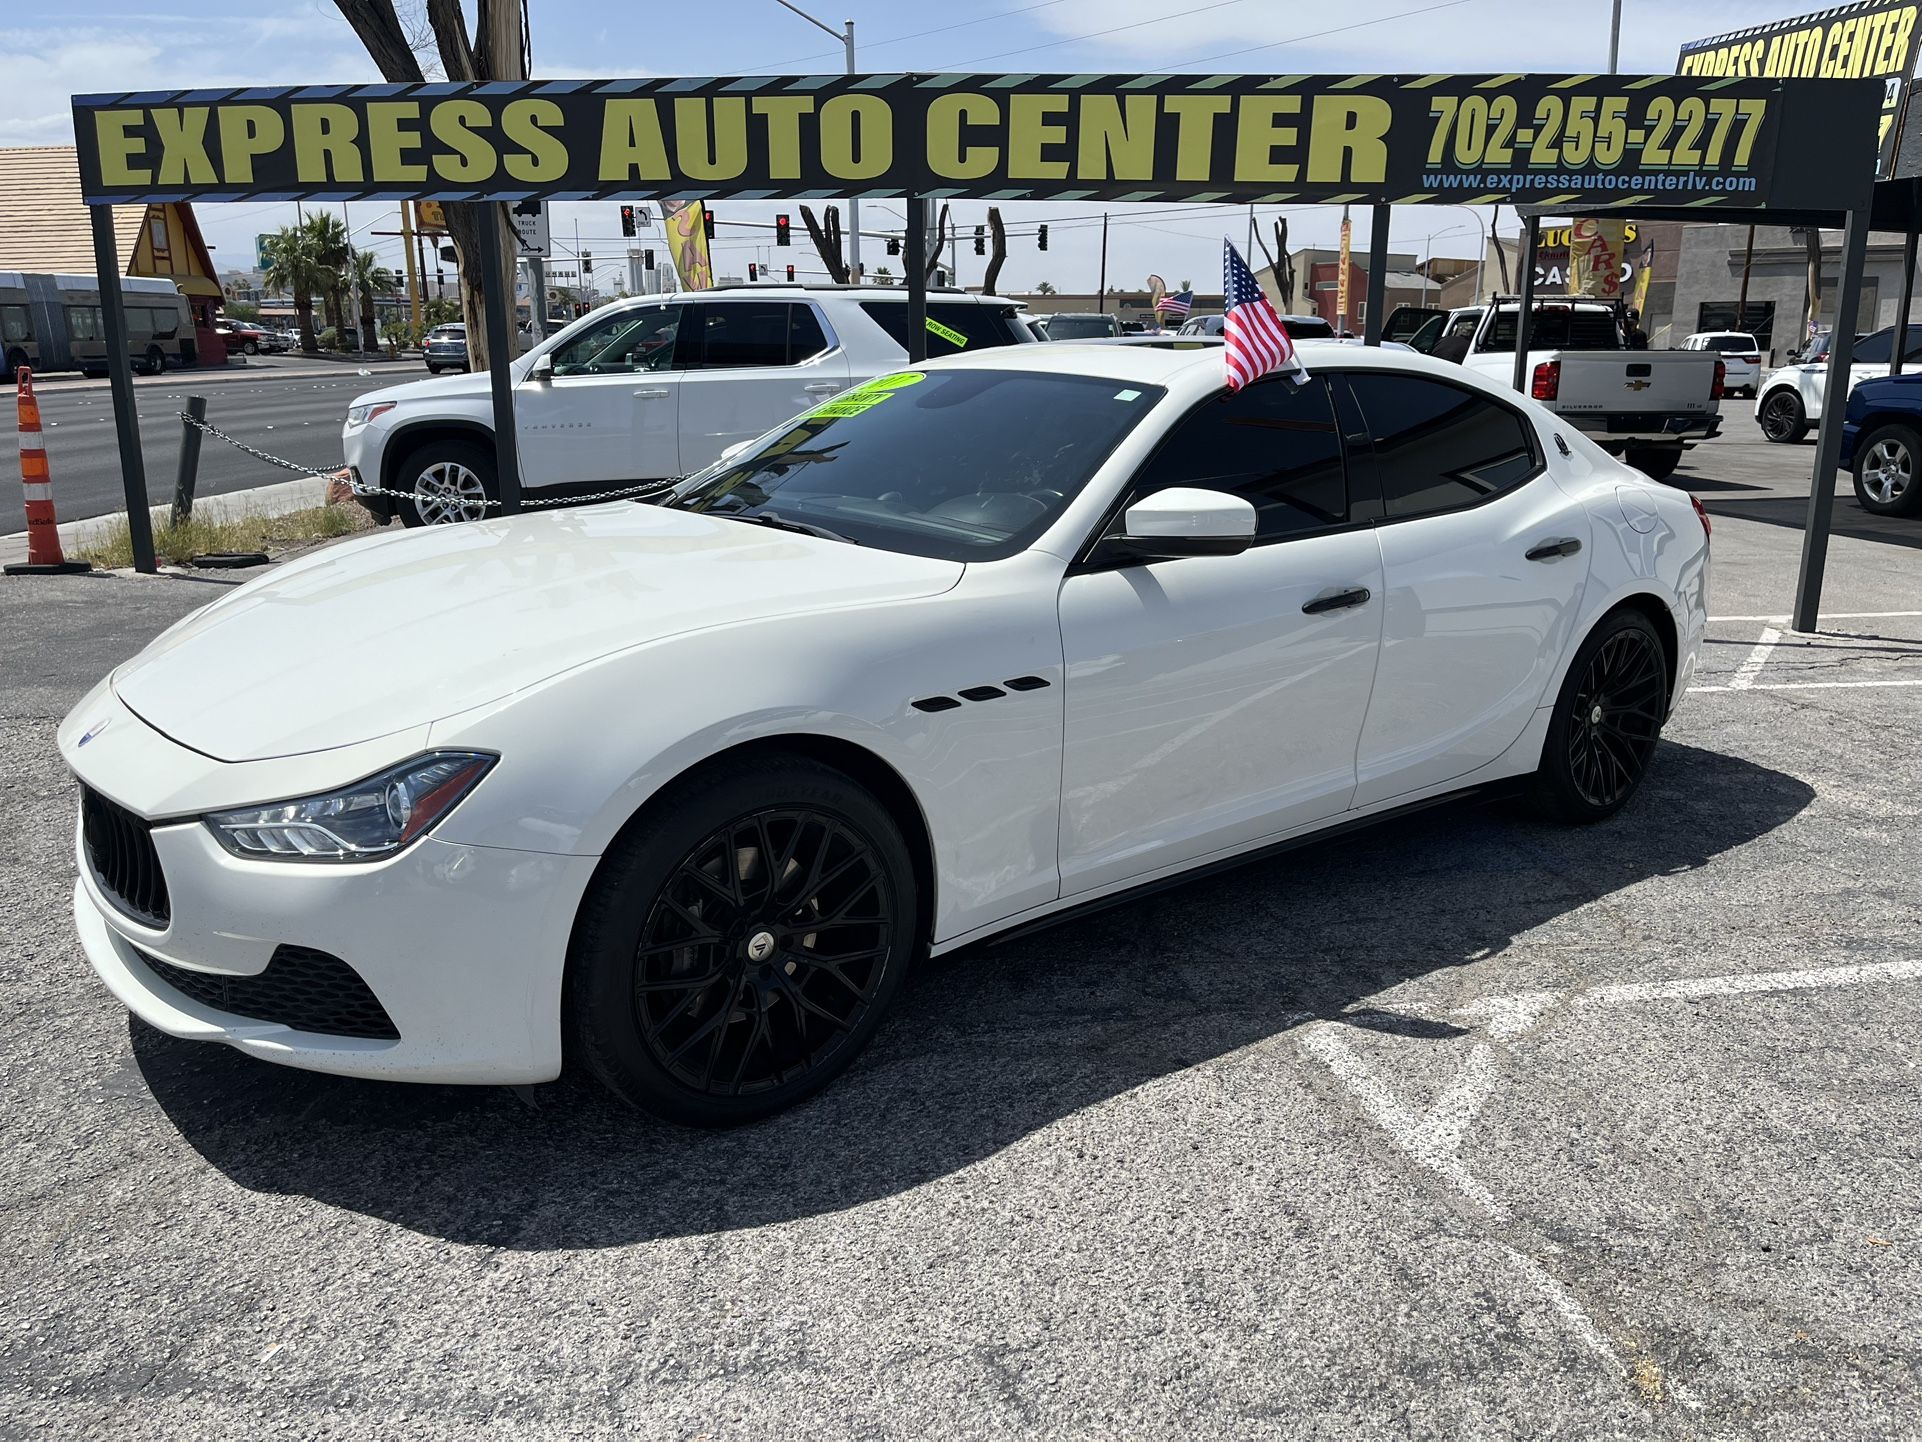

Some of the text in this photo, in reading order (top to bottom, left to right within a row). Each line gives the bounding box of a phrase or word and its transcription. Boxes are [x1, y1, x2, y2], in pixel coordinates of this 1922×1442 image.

[1763, 26, 1823, 78] AUTO
[1819, 5, 1918, 78] CENTER
[94, 92, 1394, 186] EXPRESS AUTO CENTER
[1426, 95, 1767, 171] 702-255-2277
[1422, 172, 1757, 194] www.expressautocenterlv.com
[940, 328, 966, 345] SEATING
